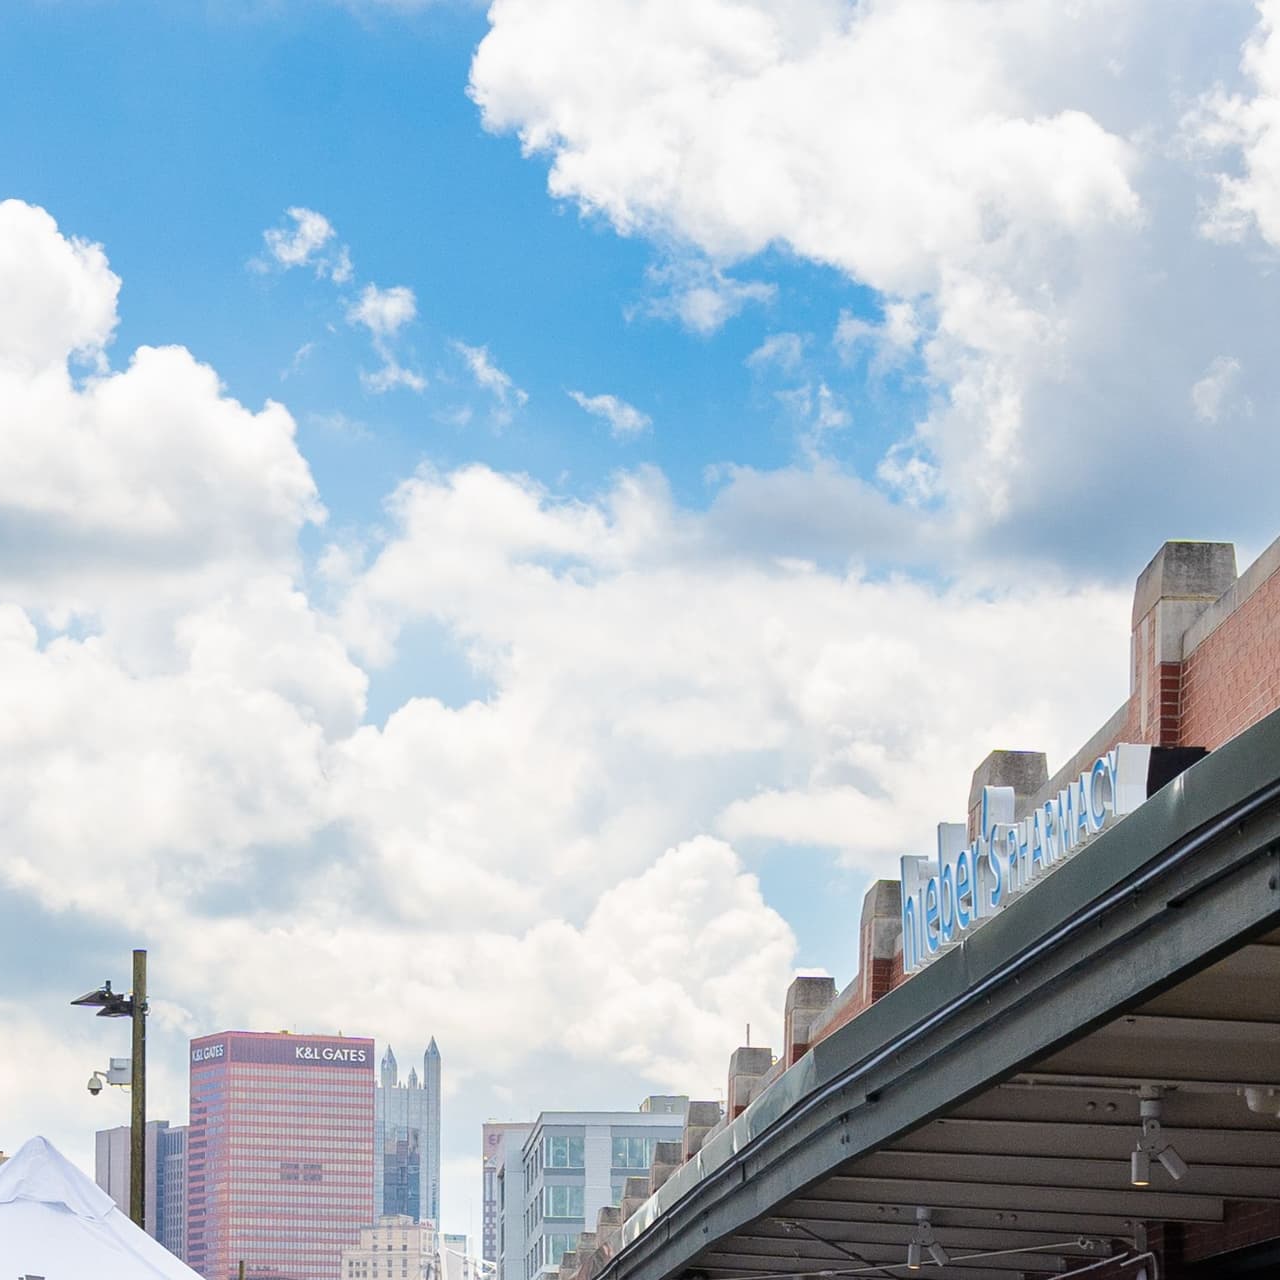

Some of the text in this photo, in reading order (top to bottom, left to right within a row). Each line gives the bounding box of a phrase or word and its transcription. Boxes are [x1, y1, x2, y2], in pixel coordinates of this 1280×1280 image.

[1007, 743, 1123, 894] PHARMACY
[204, 1045, 224, 1060] GATES
[295, 1046, 366, 1062] K&L GATES
